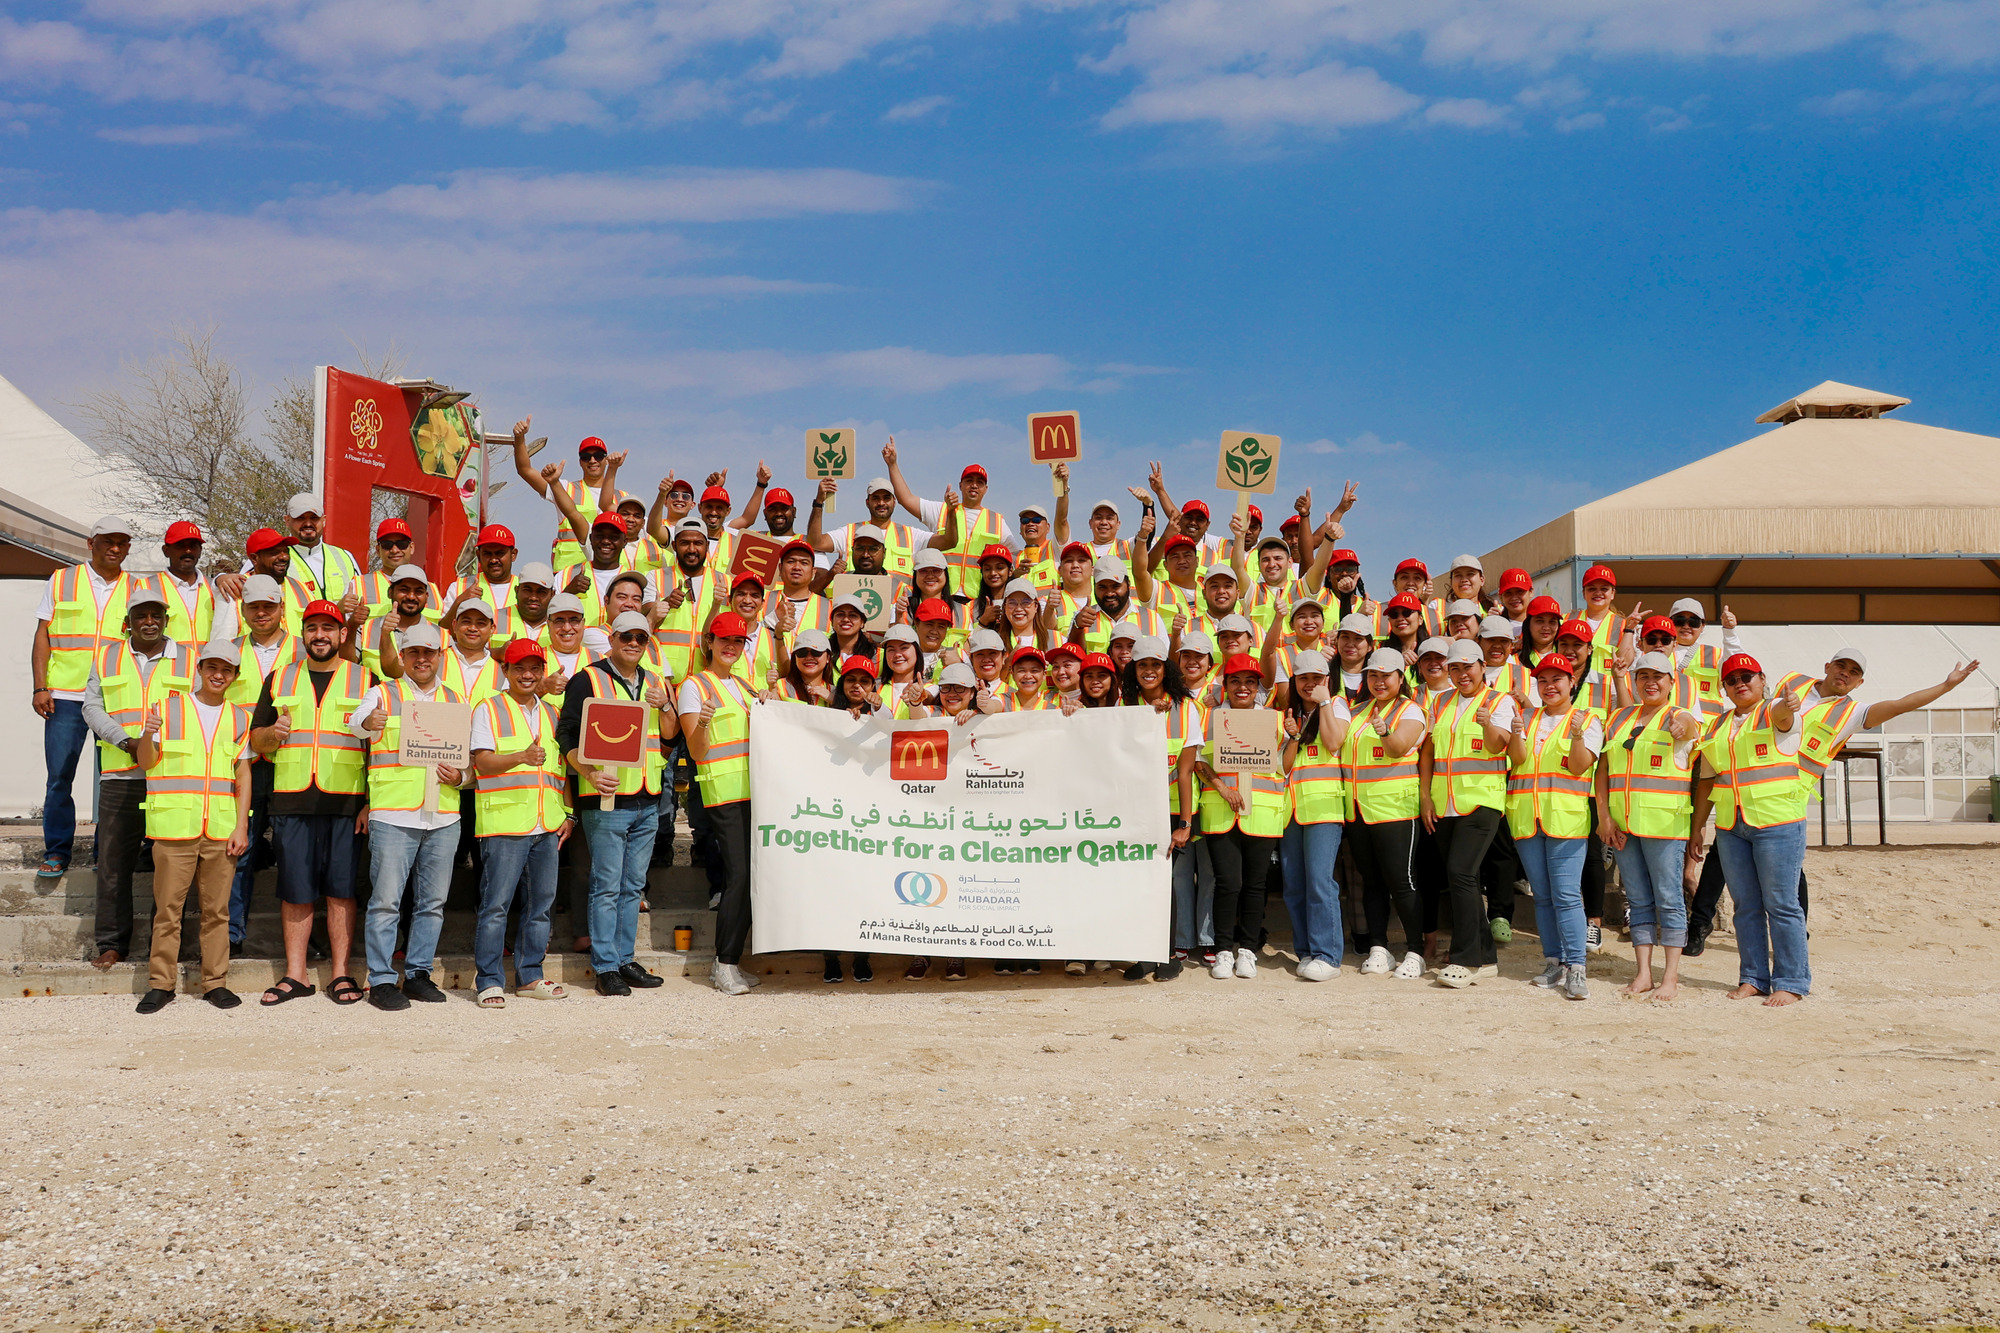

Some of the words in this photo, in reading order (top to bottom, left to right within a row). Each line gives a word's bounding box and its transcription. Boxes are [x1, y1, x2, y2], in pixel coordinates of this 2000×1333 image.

[372, 460, 385, 469] Spring
[406, 750, 462, 760] Rahlatuna
[1220, 756, 1270, 764] Rahlatuna
[966, 768, 1024, 779] رحلتنا
[901, 783, 936, 795] Qatar
[966, 780, 1024, 788] Rahlatuna
[790, 797, 844, 820] قطر
[851, 804, 880, 833] في
[888, 806, 955, 830] أنظف
[962, 810, 1012, 837] بيئة
[1074, 808, 1121, 830] معًا
[1019, 812, 1067, 837] نحو
[758, 824, 888, 856] Together
[892, 836, 934, 859] for
[938, 844, 954, 861] a
[960, 840, 1072, 863] Cleaner
[1076, 840, 1158, 867] Qatar
[958, 874, 1020, 884] مبادرة
[888, 918, 930, 933] والأغذية
[933, 924, 979, 934] للمطاعم
[982, 925, 1014, 937] المانع
[1018, 924, 1053, 936] شركة
[872, 932, 900, 941] Mana
[903, 934, 967, 945] Restaurants
